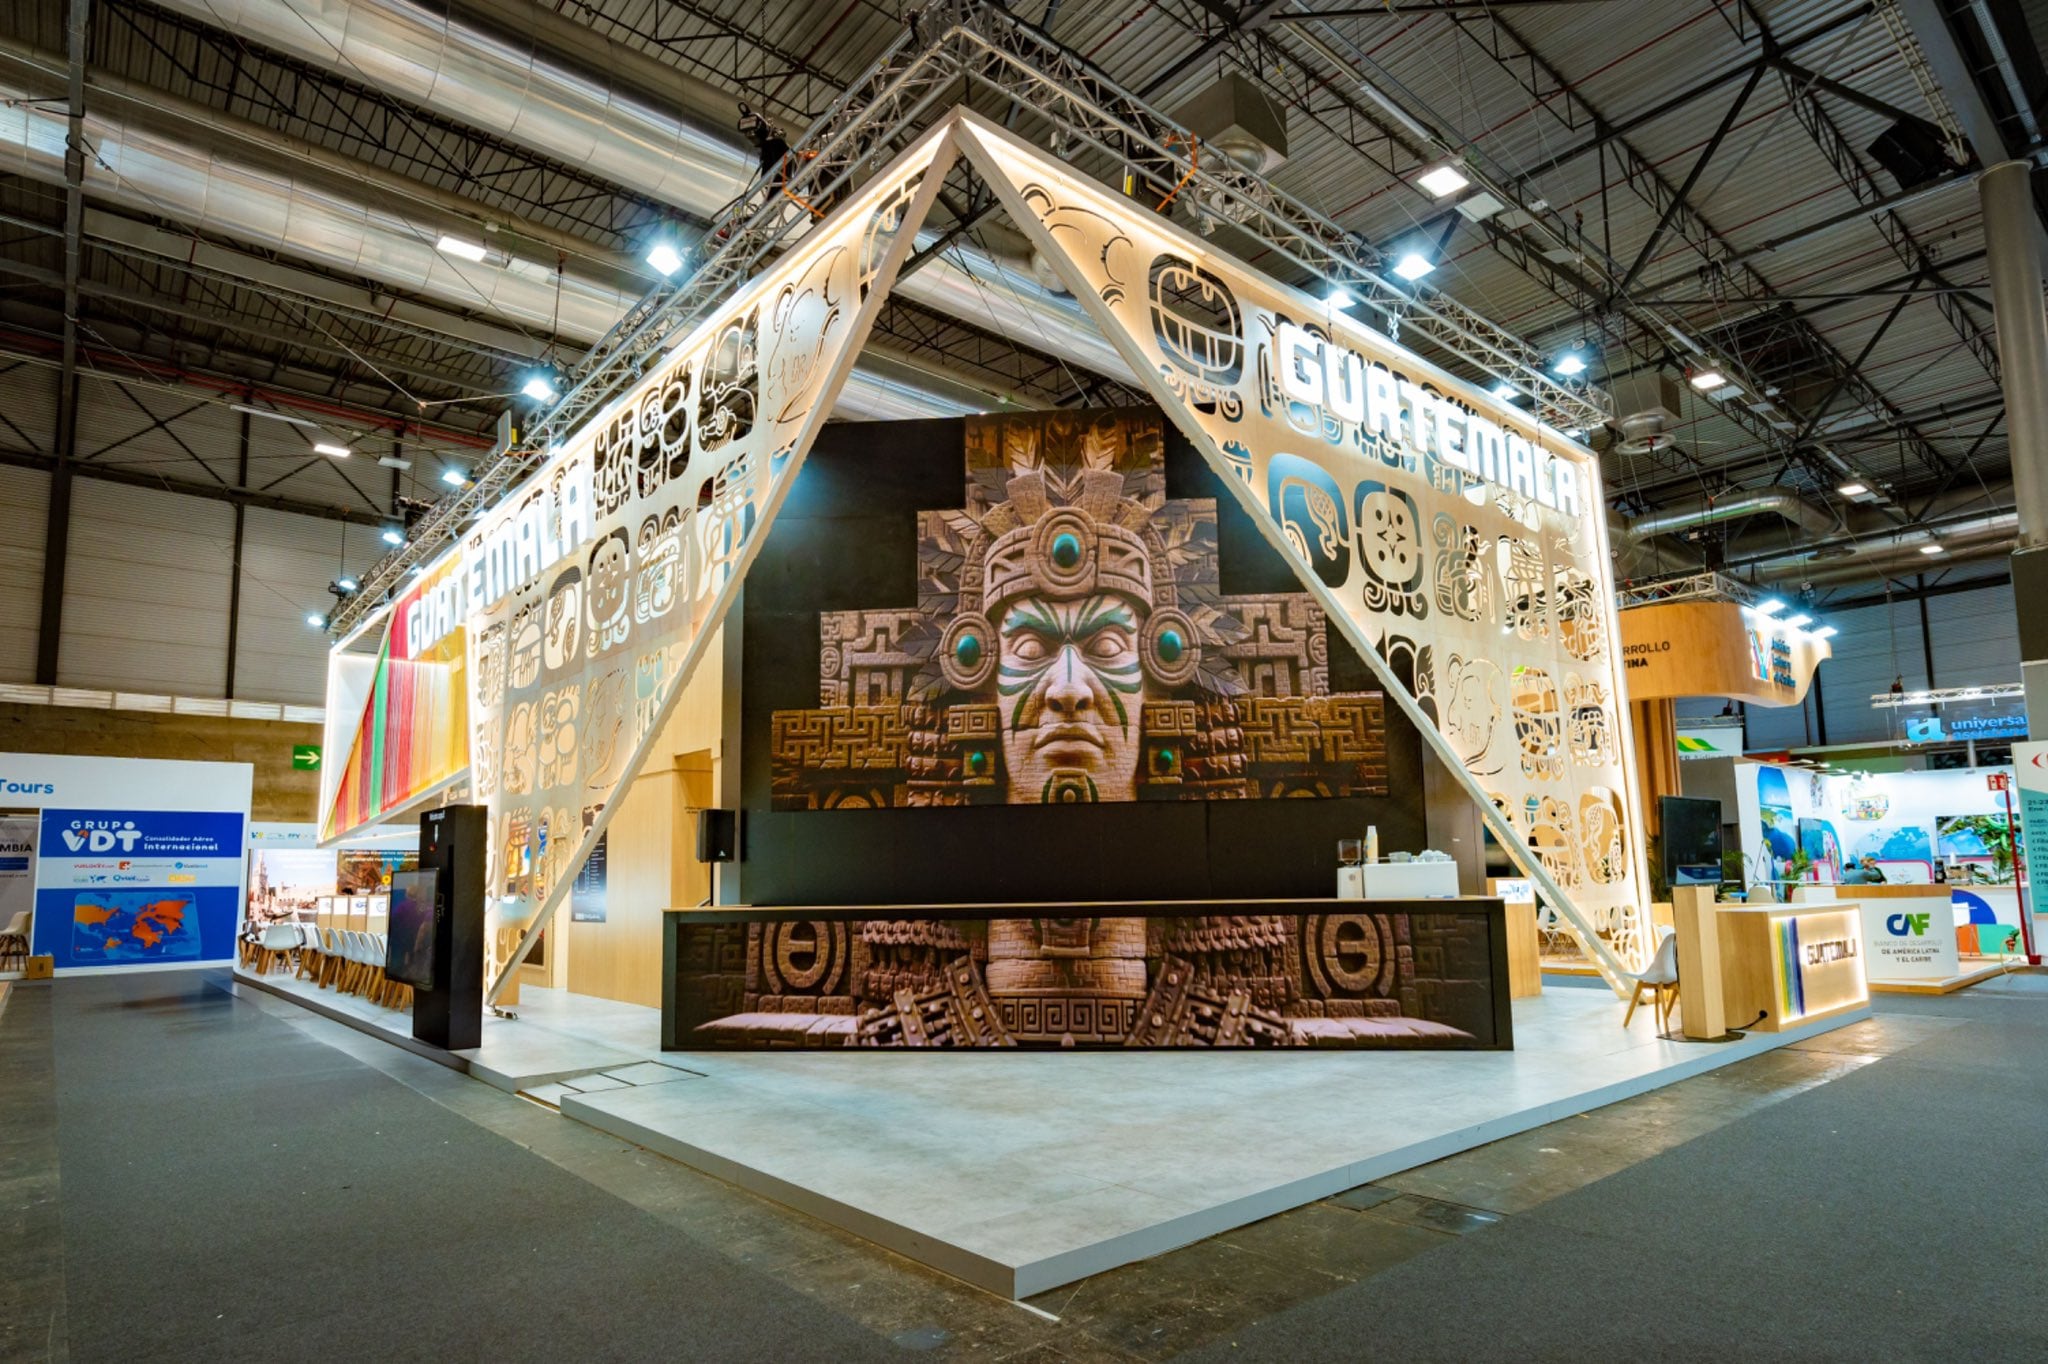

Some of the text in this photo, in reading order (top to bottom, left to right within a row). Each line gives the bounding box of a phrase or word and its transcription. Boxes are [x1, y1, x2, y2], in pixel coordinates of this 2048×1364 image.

[1275, 322, 1580, 517] GUATEMALA
[406, 462, 592, 660] GUATEMALA
[62, 829, 142, 852] VDT
[144, 842, 219, 851] Internacional
[1886, 913, 1931, 937] CAF
